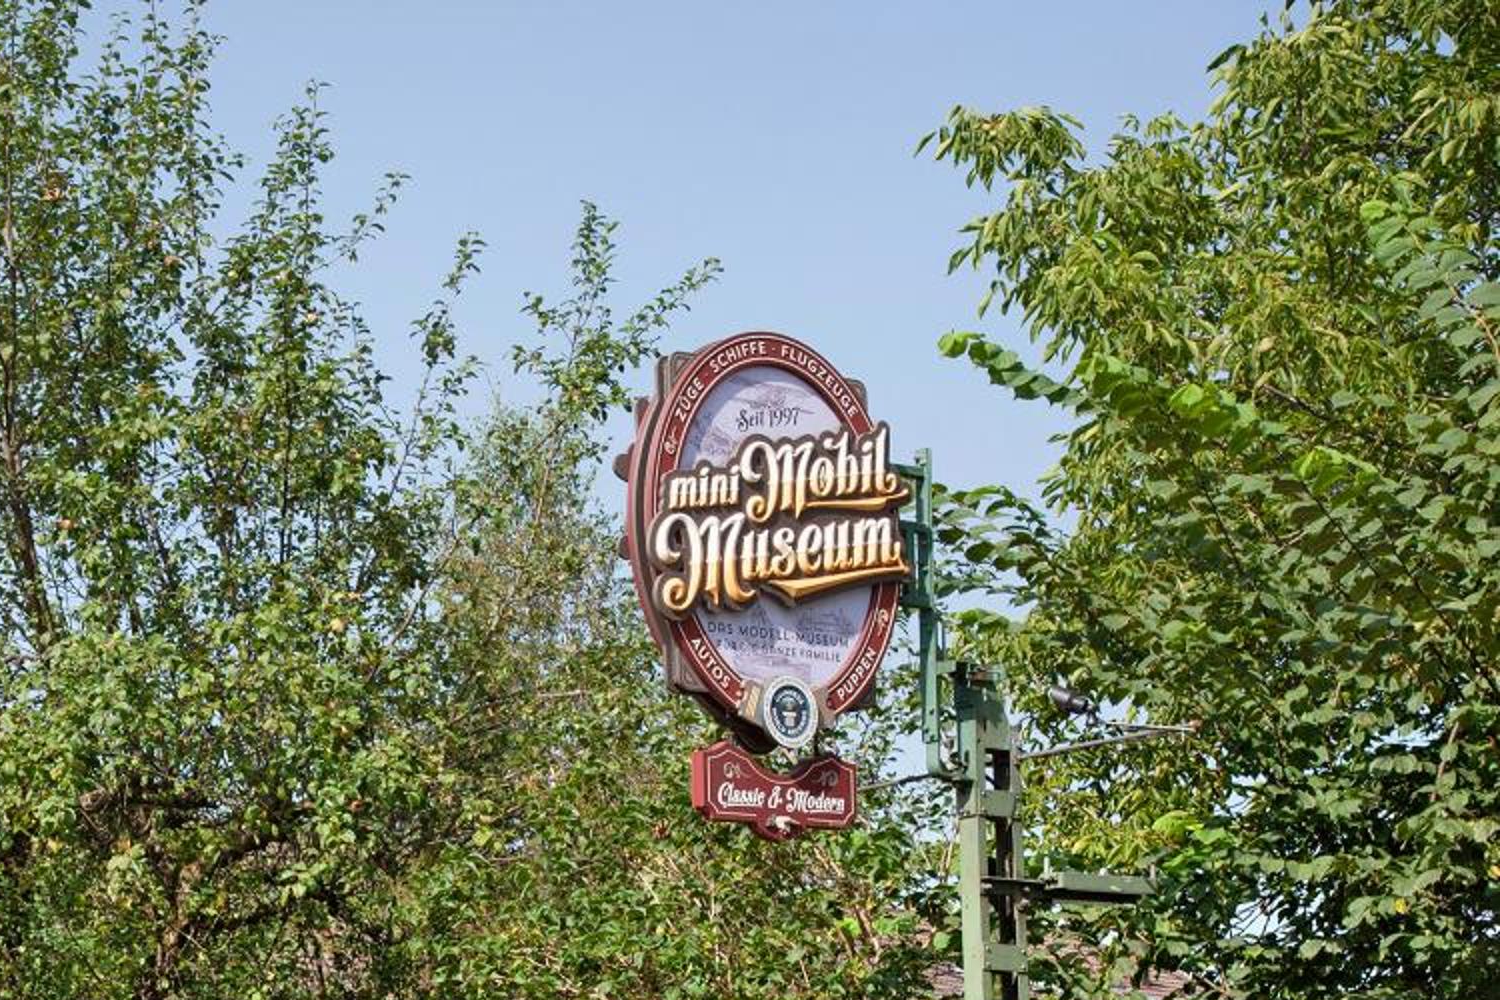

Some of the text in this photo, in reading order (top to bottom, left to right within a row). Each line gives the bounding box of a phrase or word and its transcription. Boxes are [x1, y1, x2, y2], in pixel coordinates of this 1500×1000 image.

[676, 340, 859, 422] ZÜGE SCHIFFE FLUGZEUGE
[736, 406, 802, 432] Seit 1997
[669, 428, 906, 523] mini Mobil
[655, 511, 906, 611] Museum
[739, 625, 850, 648] MODELL-MUSEUM
[691, 638, 731, 689] AUTOS
[836, 647, 878, 700] PUPPEN
[717, 782, 765, 809] Classic
[786, 787, 845, 814] Modern
